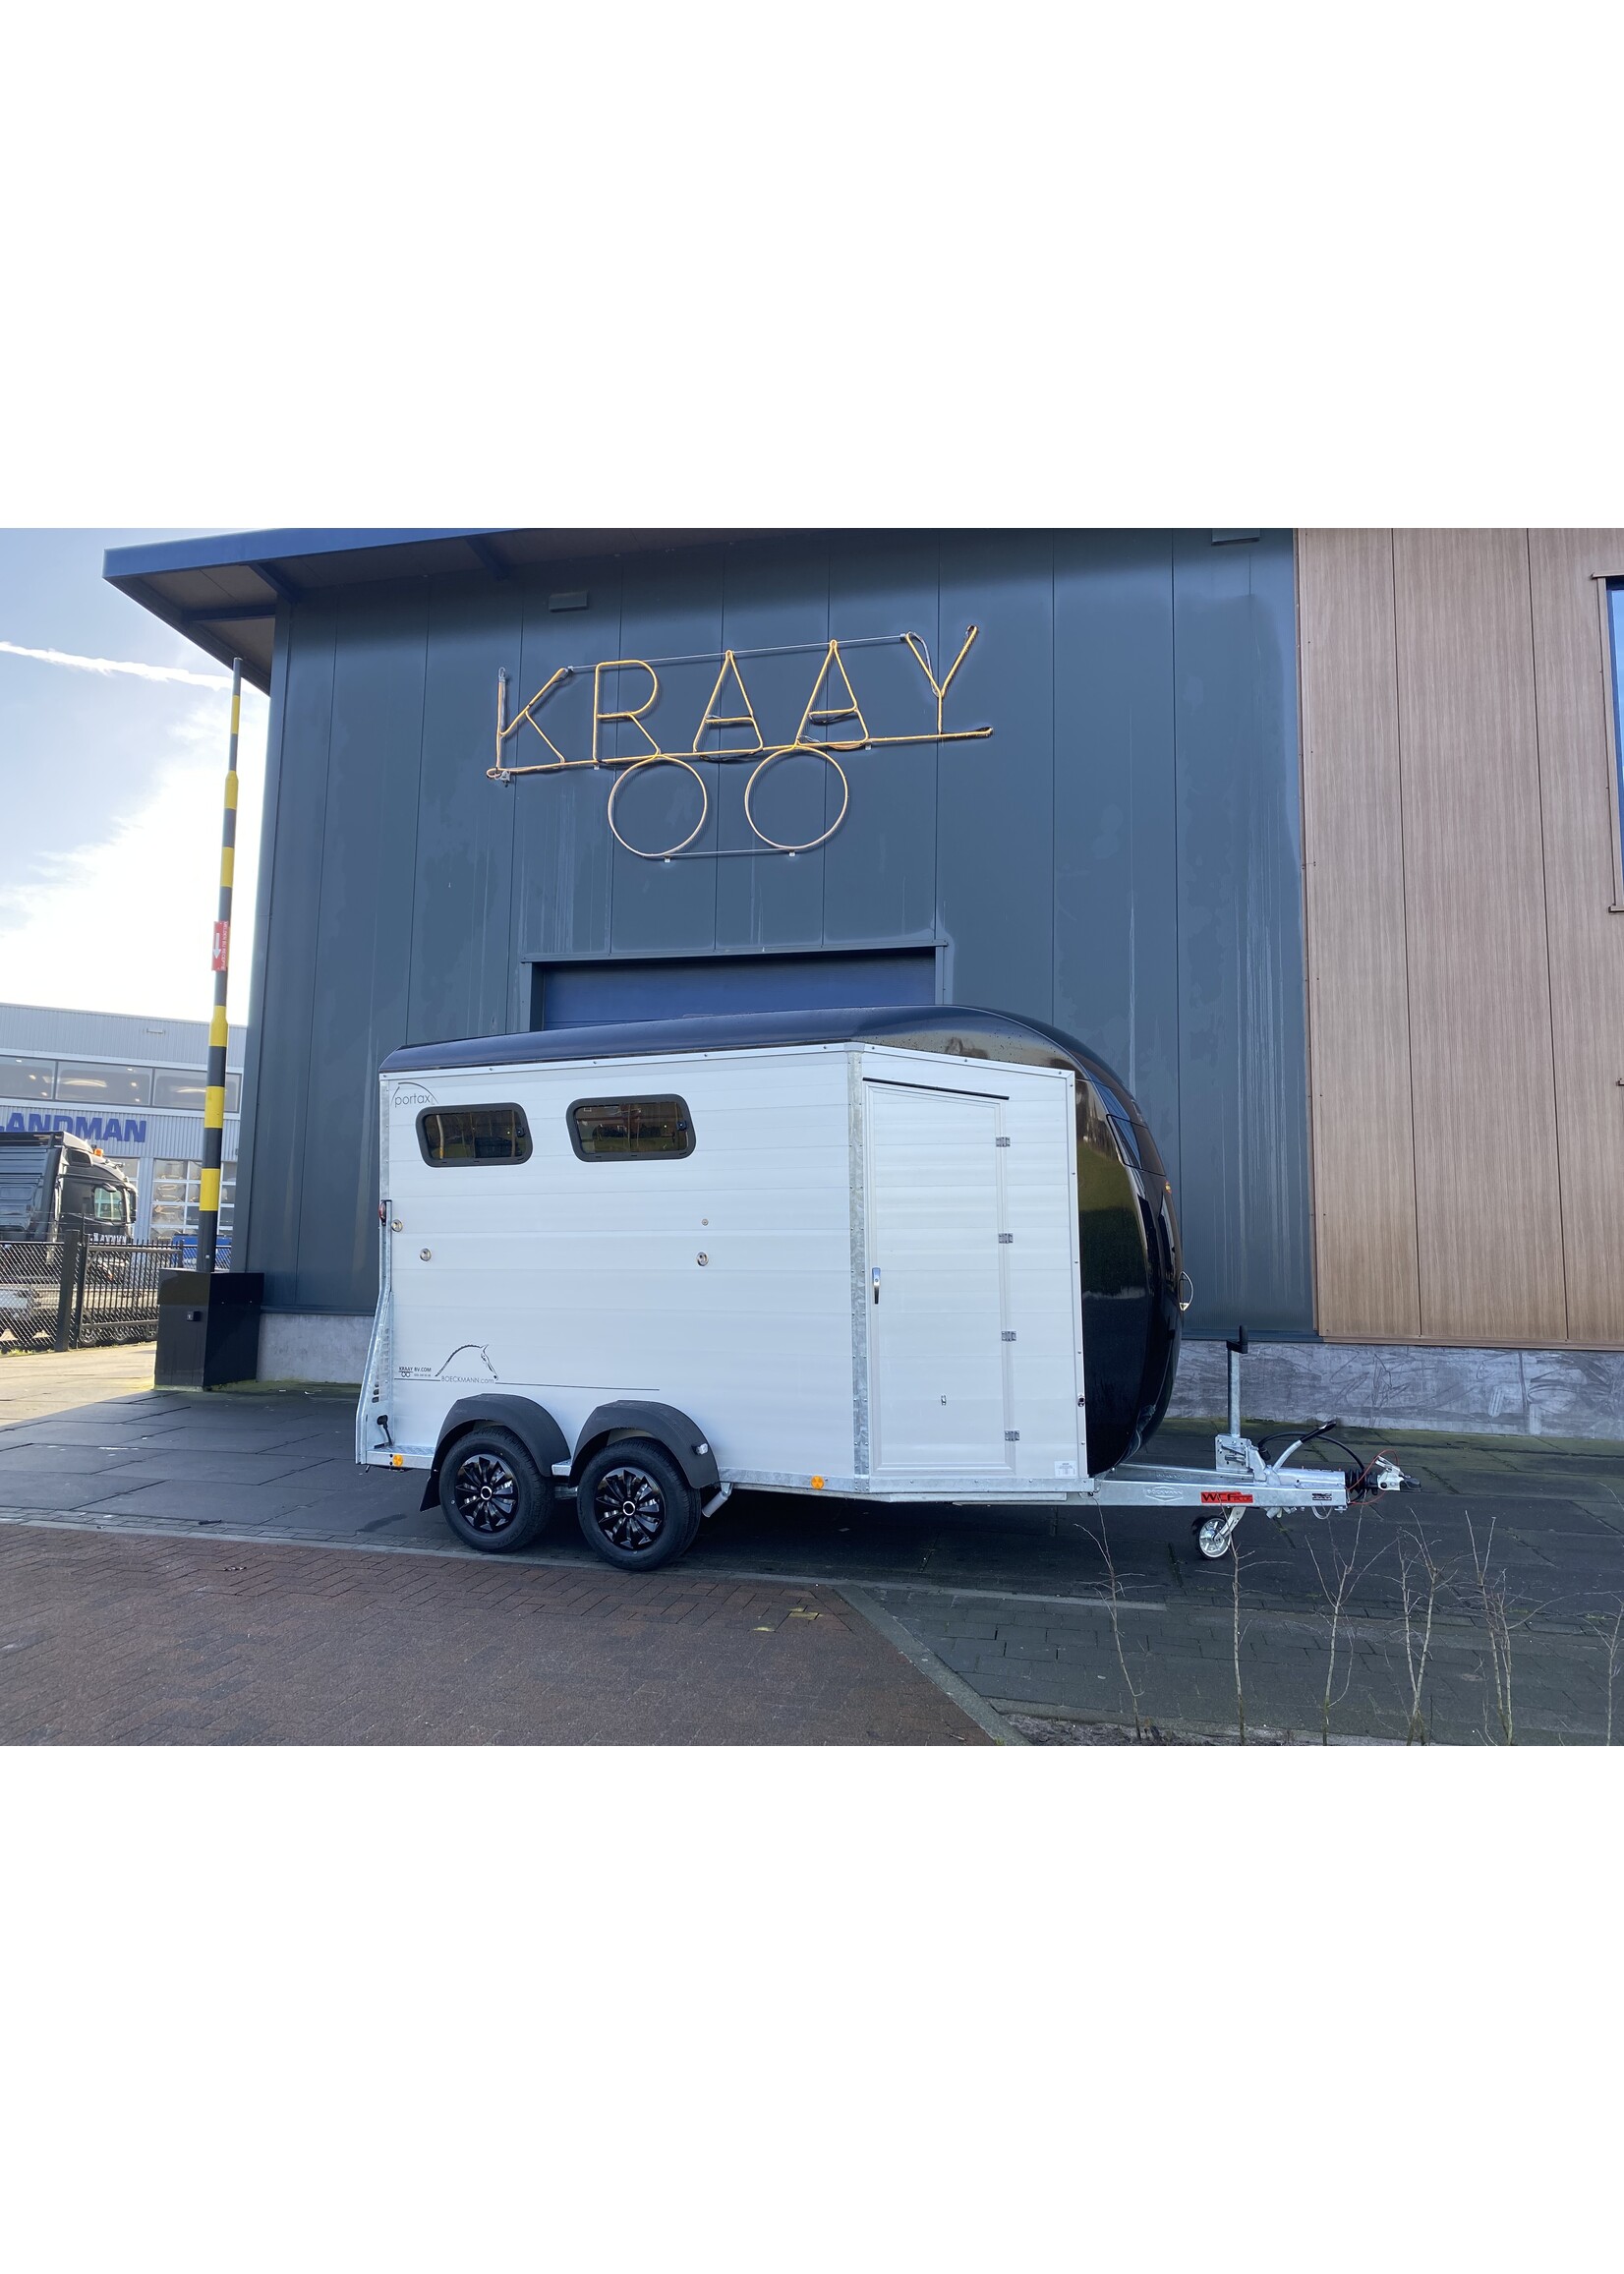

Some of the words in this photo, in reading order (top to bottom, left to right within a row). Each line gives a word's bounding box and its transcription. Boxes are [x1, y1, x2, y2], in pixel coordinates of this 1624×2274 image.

[494, 624, 979, 773] KRAAY
[394, 1093, 431, 1108] portax
[0, 1112, 146, 1142] ANDMAN
[441, 1375, 494, 1384] BOECKMANN.com
